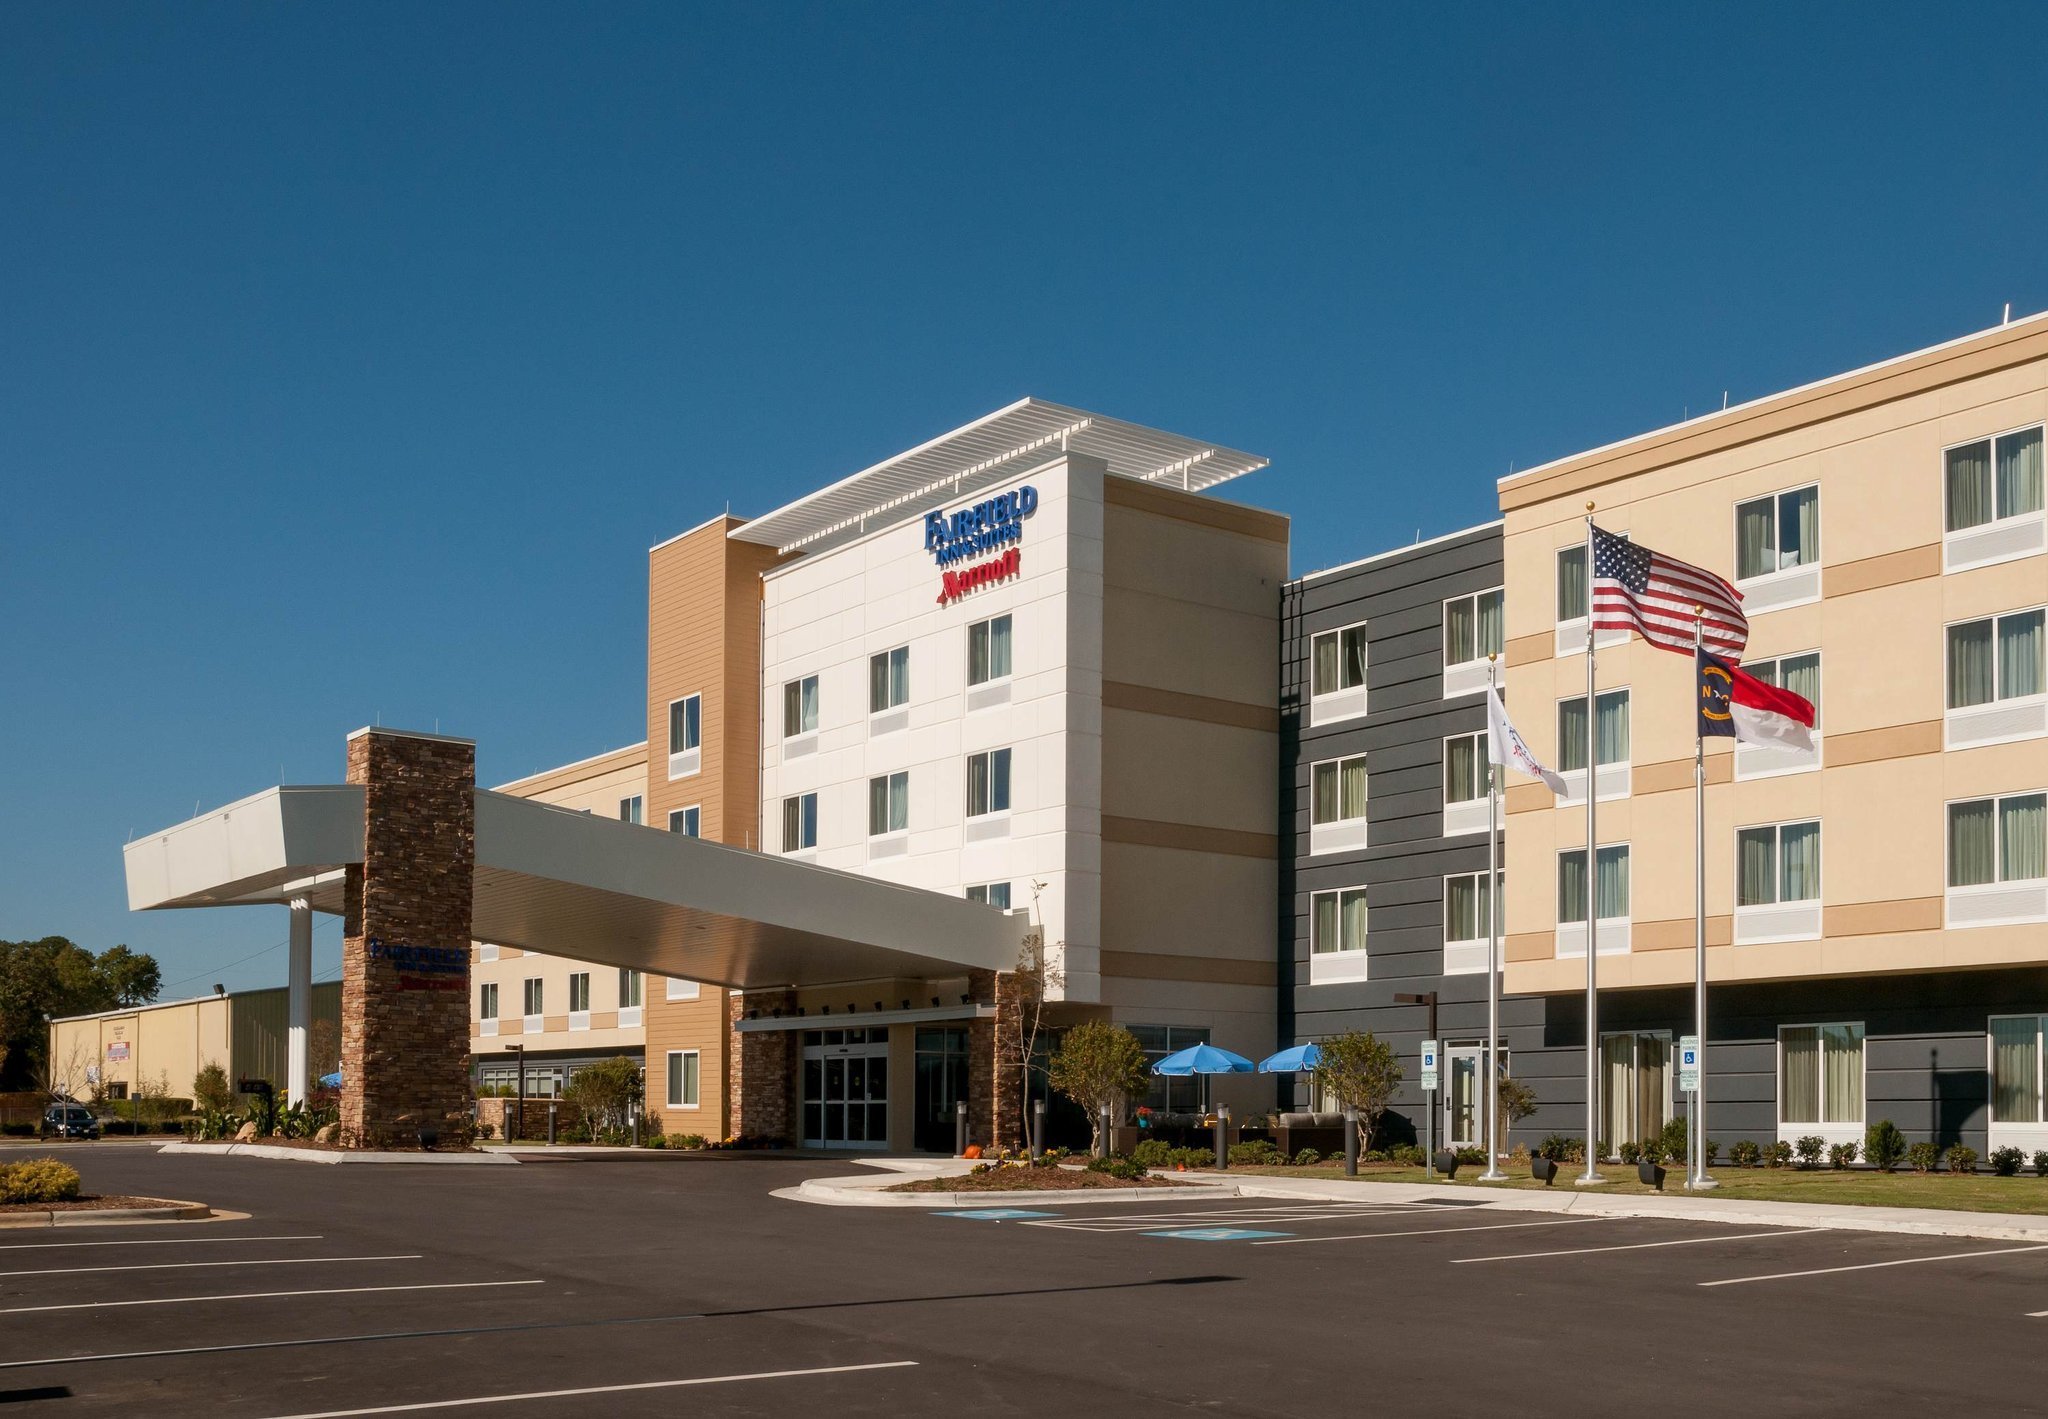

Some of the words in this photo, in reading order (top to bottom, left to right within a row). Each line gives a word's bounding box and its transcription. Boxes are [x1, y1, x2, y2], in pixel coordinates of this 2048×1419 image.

[924, 485, 1038, 550] FAIRFIELD
[935, 541, 962, 565] INN
[973, 520, 1022, 551] SUITES
[936, 547, 1020, 605] Marriott
[1702, 685, 1711, 698] N
